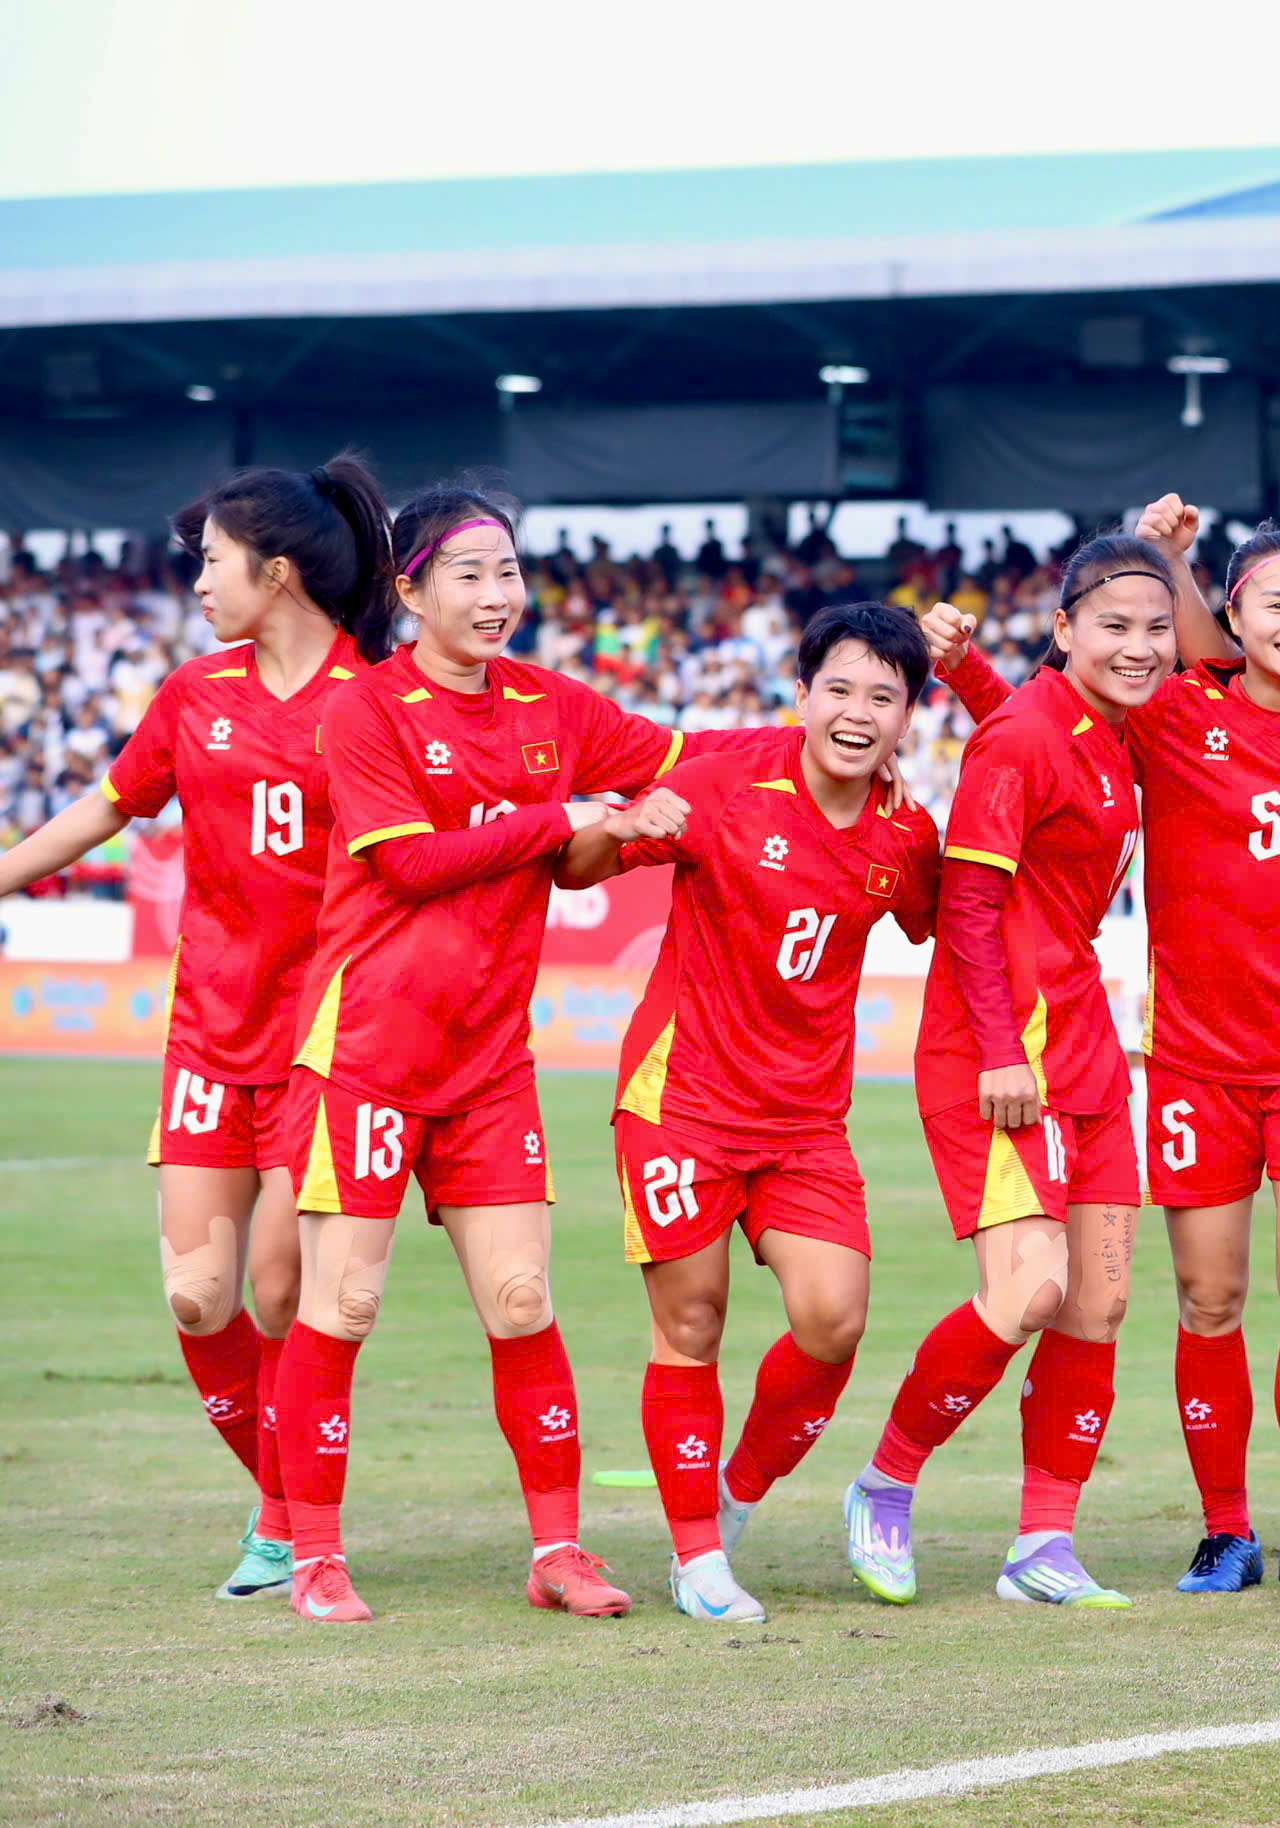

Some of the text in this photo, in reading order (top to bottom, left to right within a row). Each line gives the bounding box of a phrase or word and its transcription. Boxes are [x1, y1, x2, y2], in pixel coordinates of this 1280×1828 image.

[251, 780, 303, 857] 19
[776, 907, 838, 982] 21
[168, 1068, 225, 1134] 19
[1162, 1099, 1197, 1172] 5
[355, 1102, 404, 1181] 13
[1043, 1115, 1068, 1185] 11
[643, 1155, 700, 1228] 21
